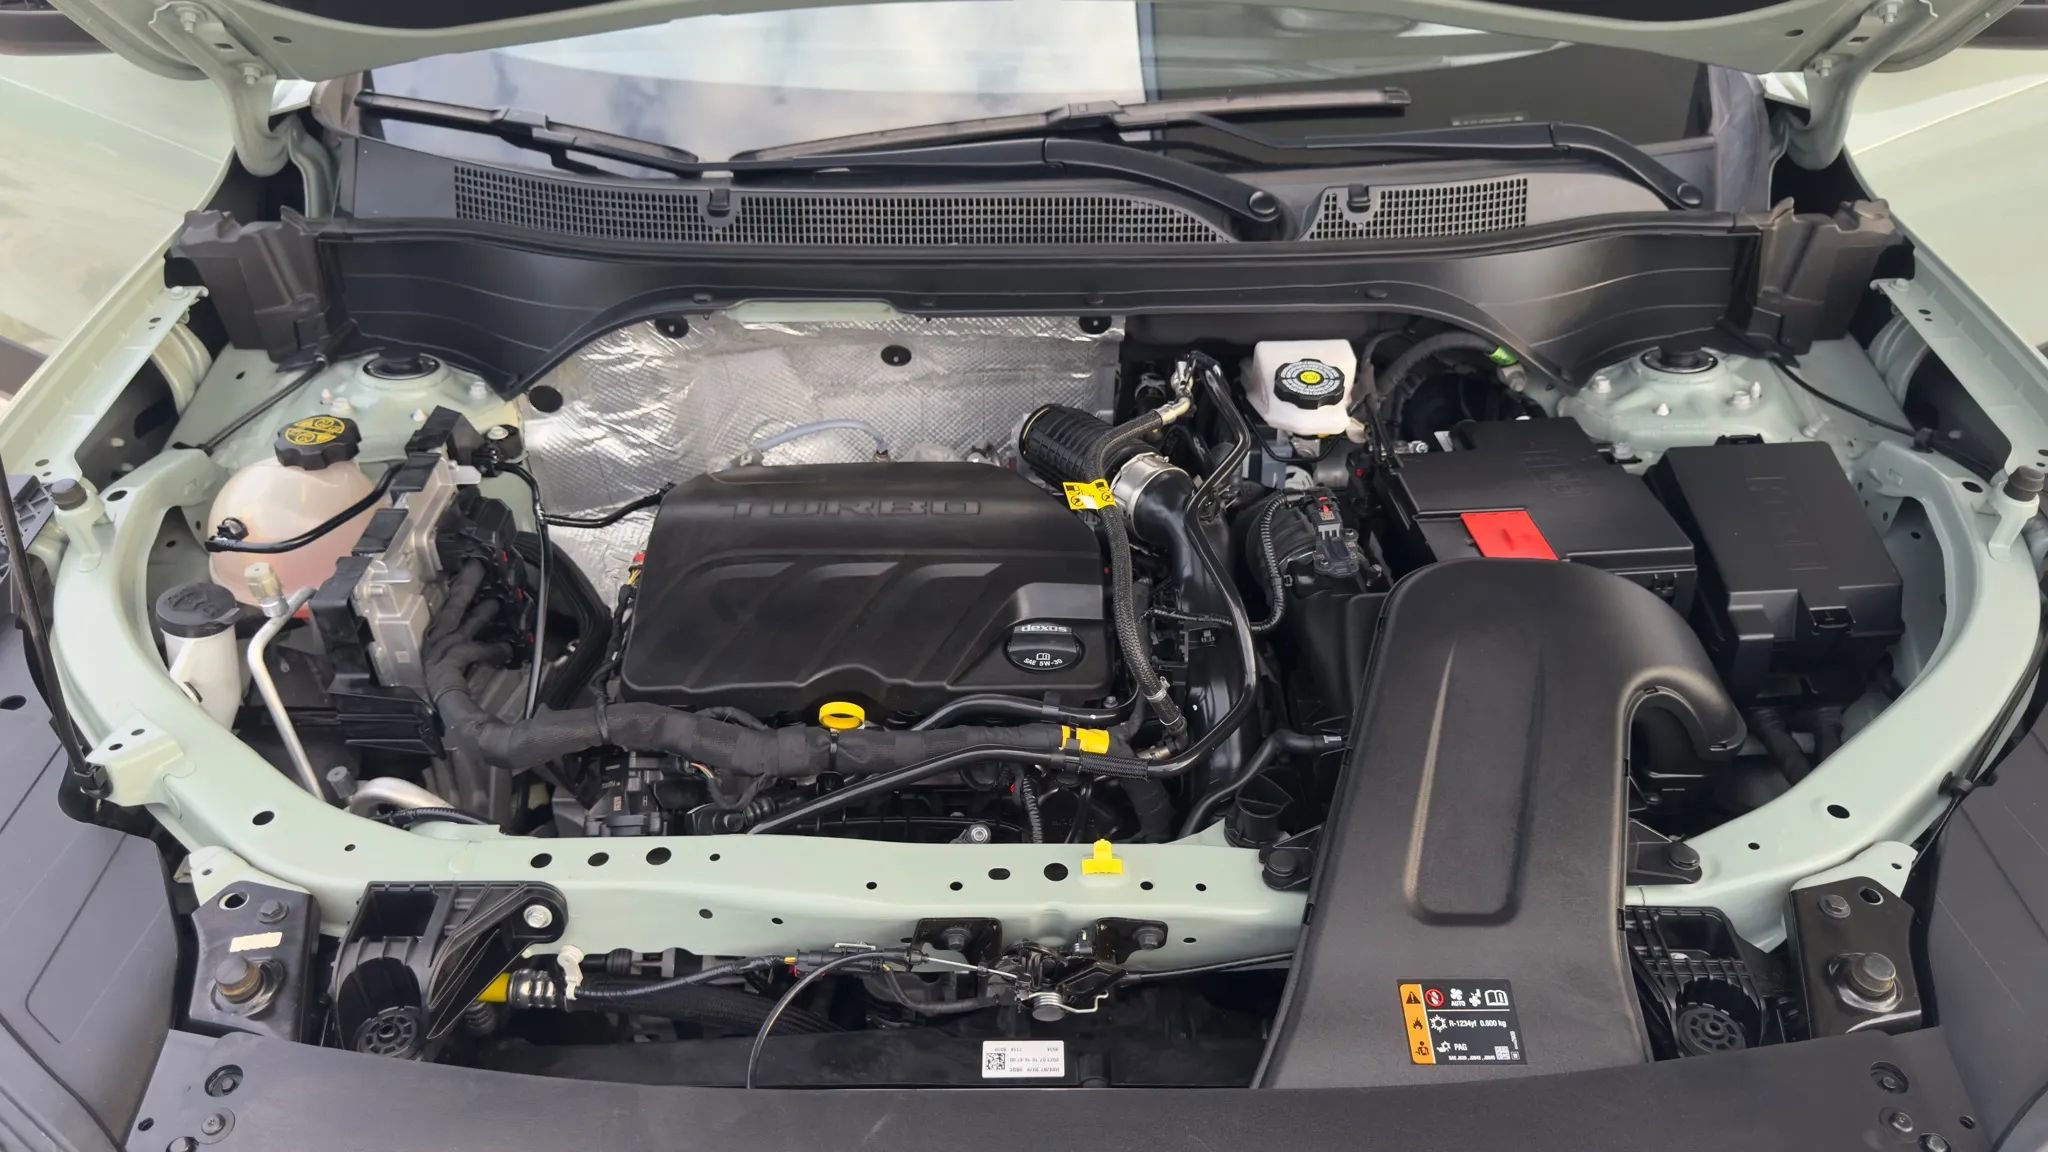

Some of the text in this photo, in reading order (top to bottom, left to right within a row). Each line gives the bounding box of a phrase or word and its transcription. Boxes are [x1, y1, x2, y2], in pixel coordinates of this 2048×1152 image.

[719, 500, 981, 516] TURBO
[1021, 624, 1067, 632] dexos
[1023, 658, 1037, 666] SAE
[1449, 1020, 1477, 1028] R-1234yf
[1498, 1020, 1507, 1028] kg
[1454, 1043, 1468, 1051] PAG
